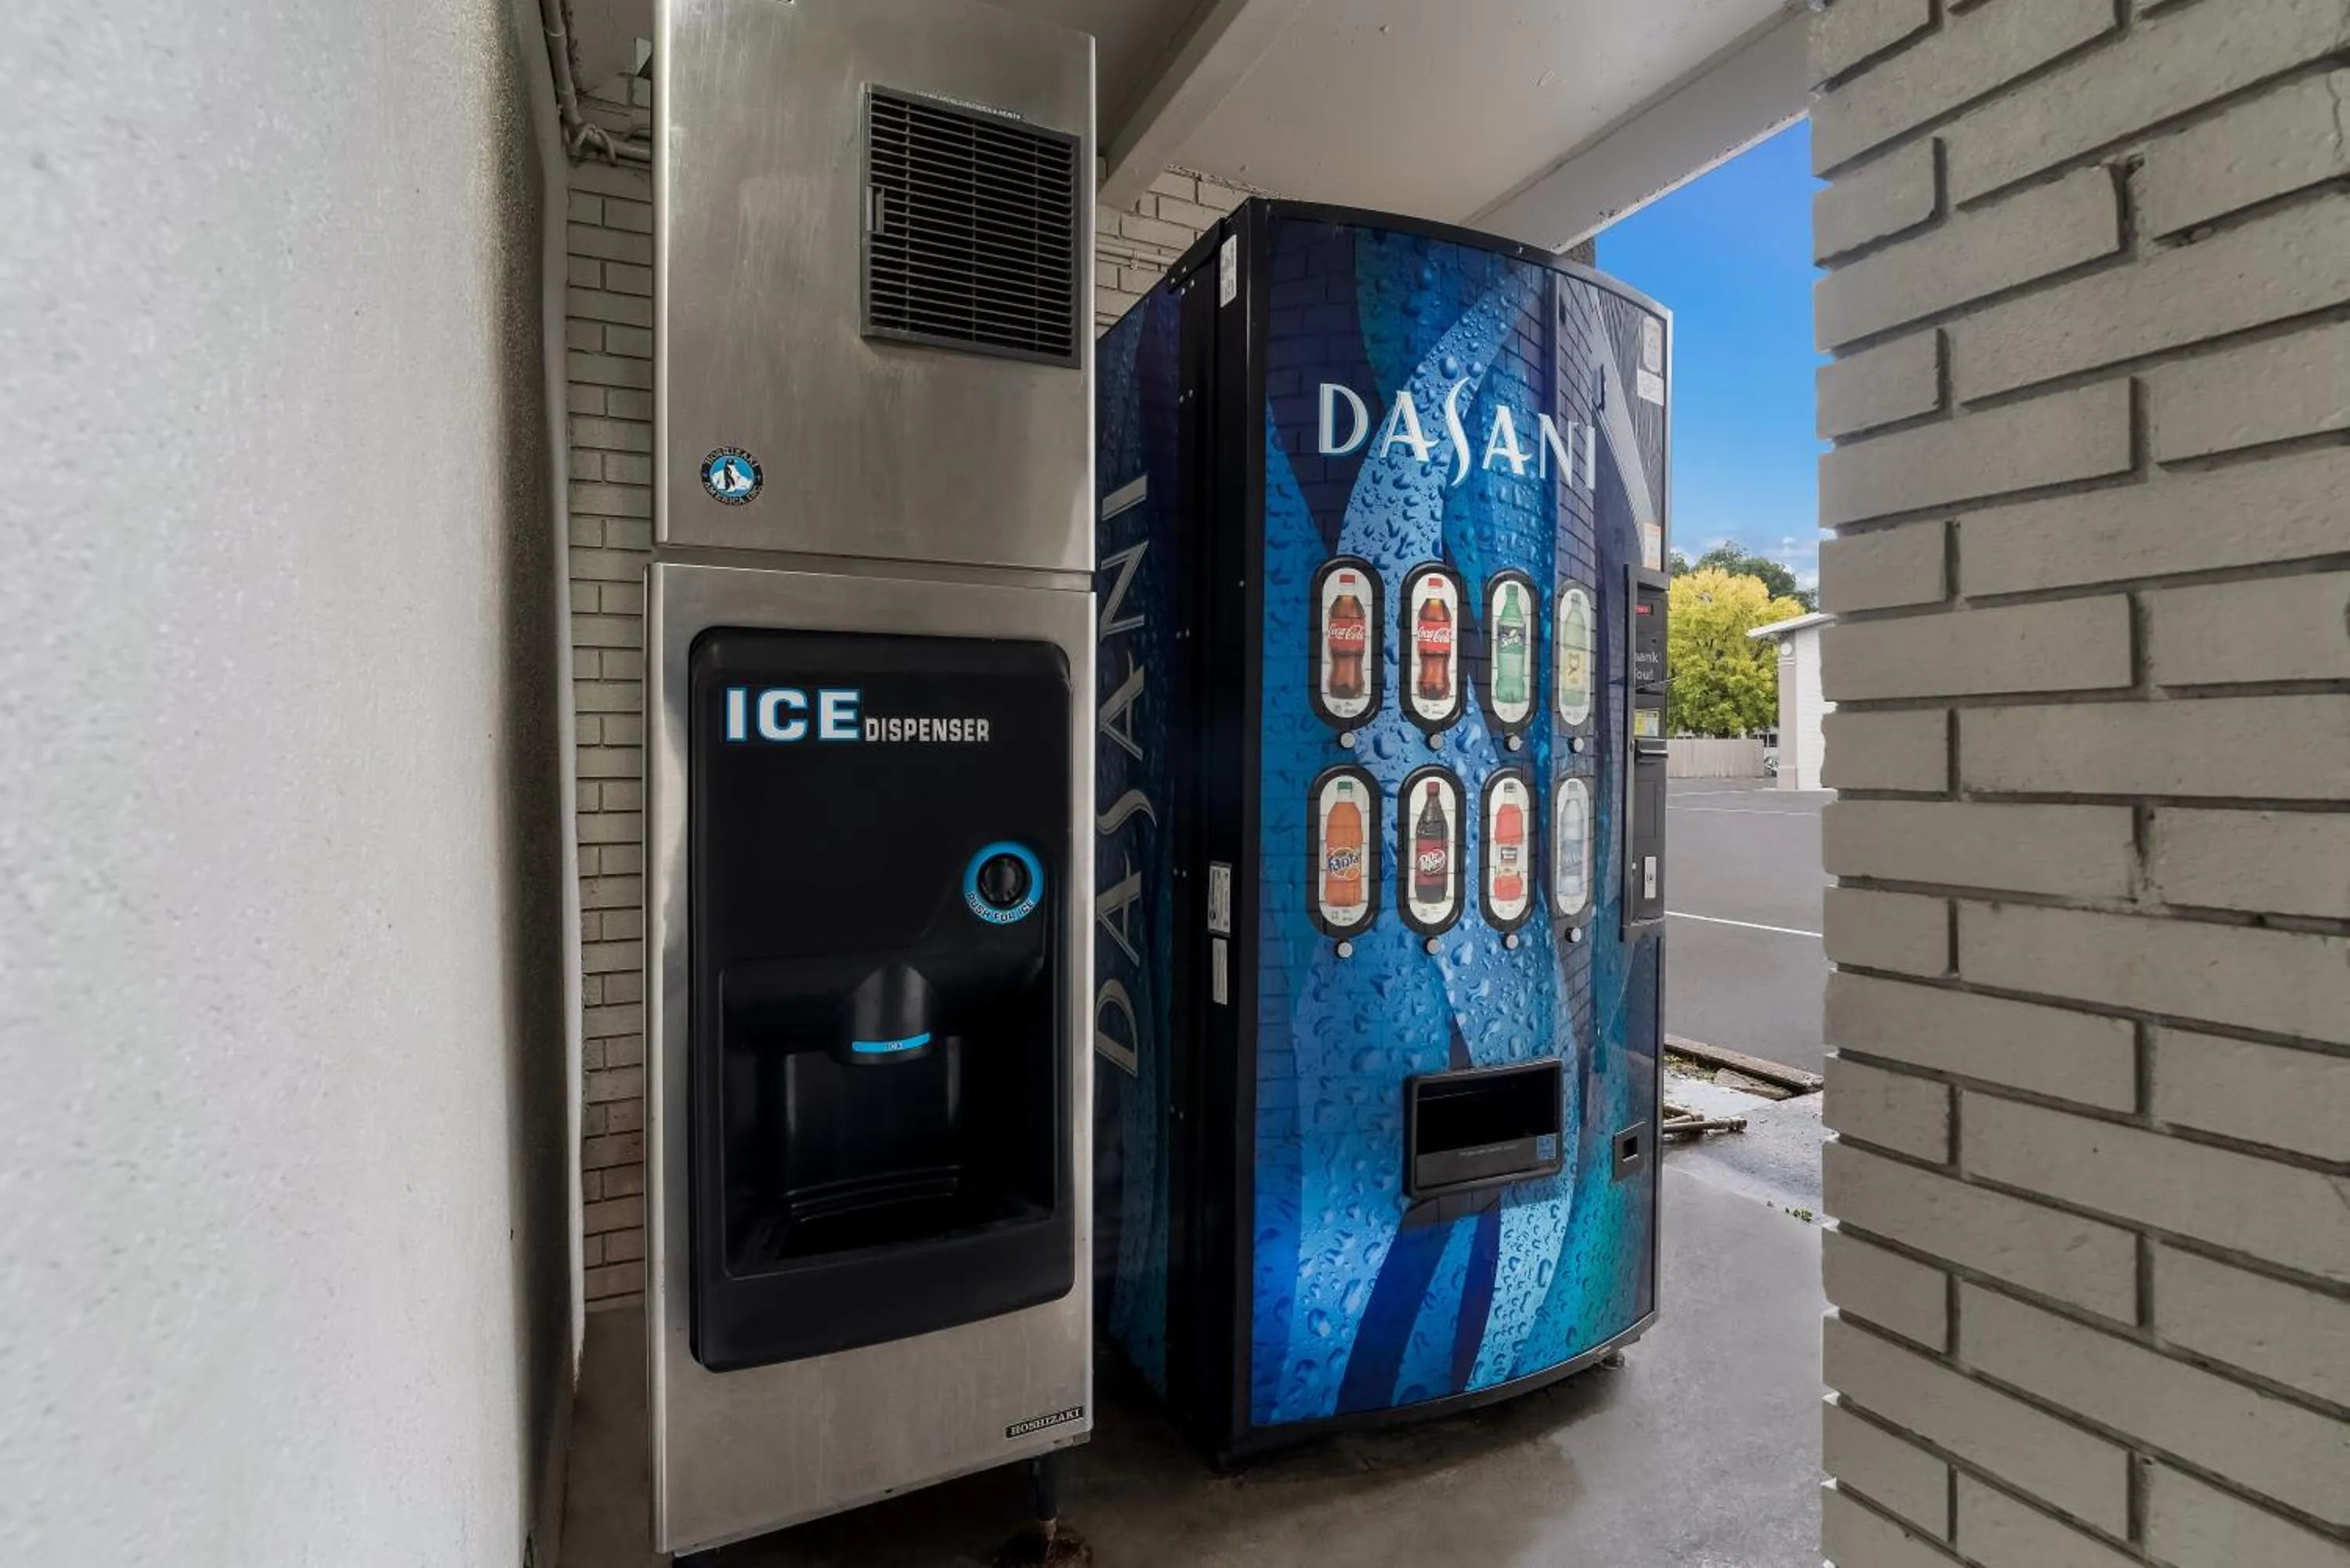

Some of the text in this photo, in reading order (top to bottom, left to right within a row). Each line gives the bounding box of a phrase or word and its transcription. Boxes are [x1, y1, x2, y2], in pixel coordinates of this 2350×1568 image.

[1318, 377, 1596, 490] DASANI
[1635, 652, 1659, 663] ank
[726, 687, 990, 742] ICE DISPENSER
[1095, 475, 1157, 1078] DASANI
[965, 891, 1035, 923] PUSH FOR ICE
